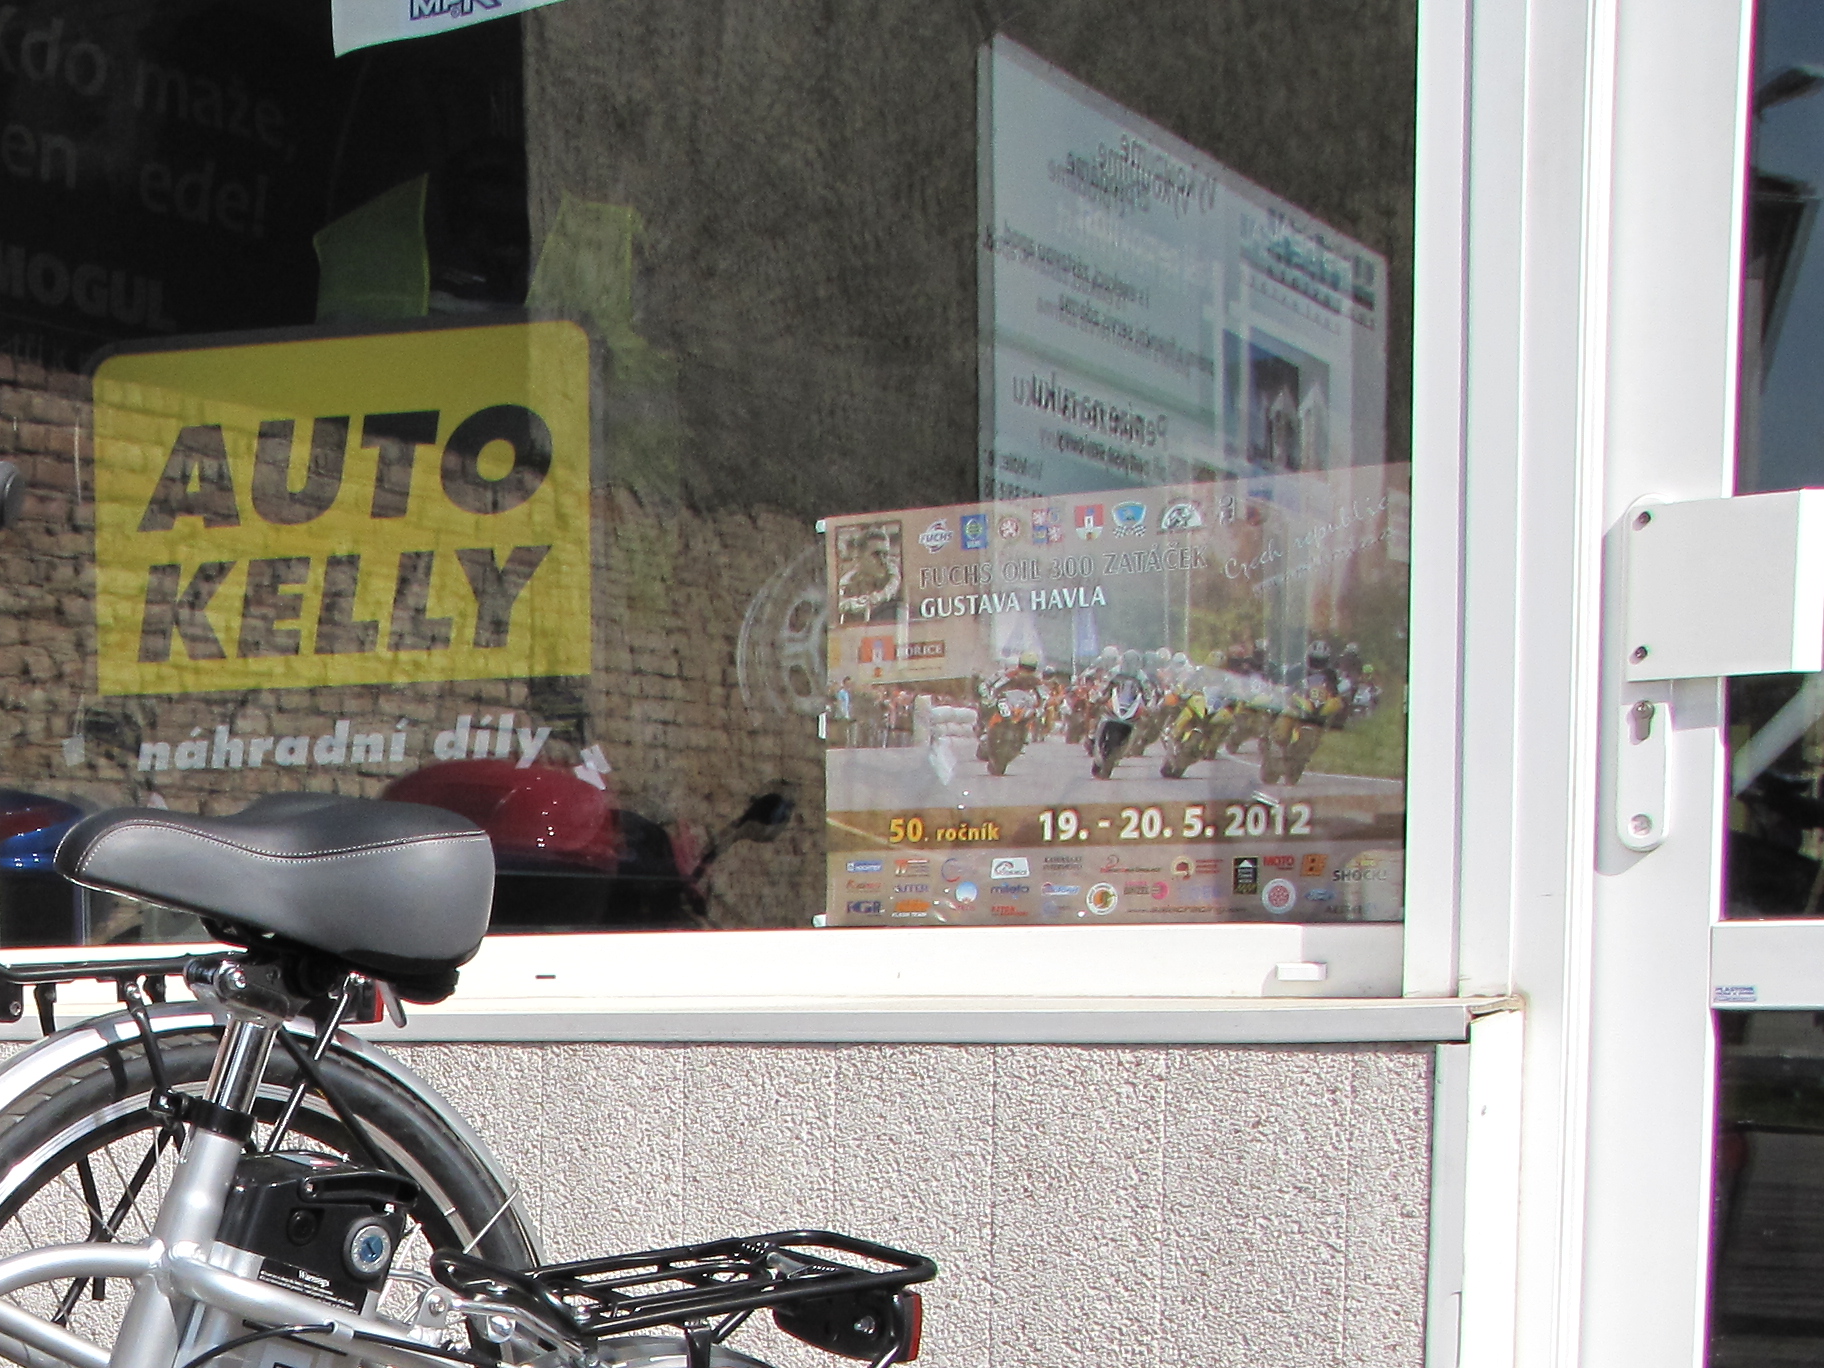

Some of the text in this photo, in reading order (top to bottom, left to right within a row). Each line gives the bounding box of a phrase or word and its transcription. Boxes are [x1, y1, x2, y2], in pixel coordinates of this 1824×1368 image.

[137, 403, 553, 532] AUTO
[920, 543, 1208, 589] FUCHS OIL 300 ZATÁČEK
[137, 544, 553, 663] KELLY
[920, 585, 1107, 620] GUSTAVA HAVLA
[137, 713, 551, 772] náhradní díly
[888, 817, 930, 843] 50.
[936, 821, 1000, 842] ročník
[1038, 808, 1089, 842] 19.
[1118, 805, 1174, 839] 20.
[1182, 805, 1216, 838] 5.
[1224, 801, 1313, 837] 2012
